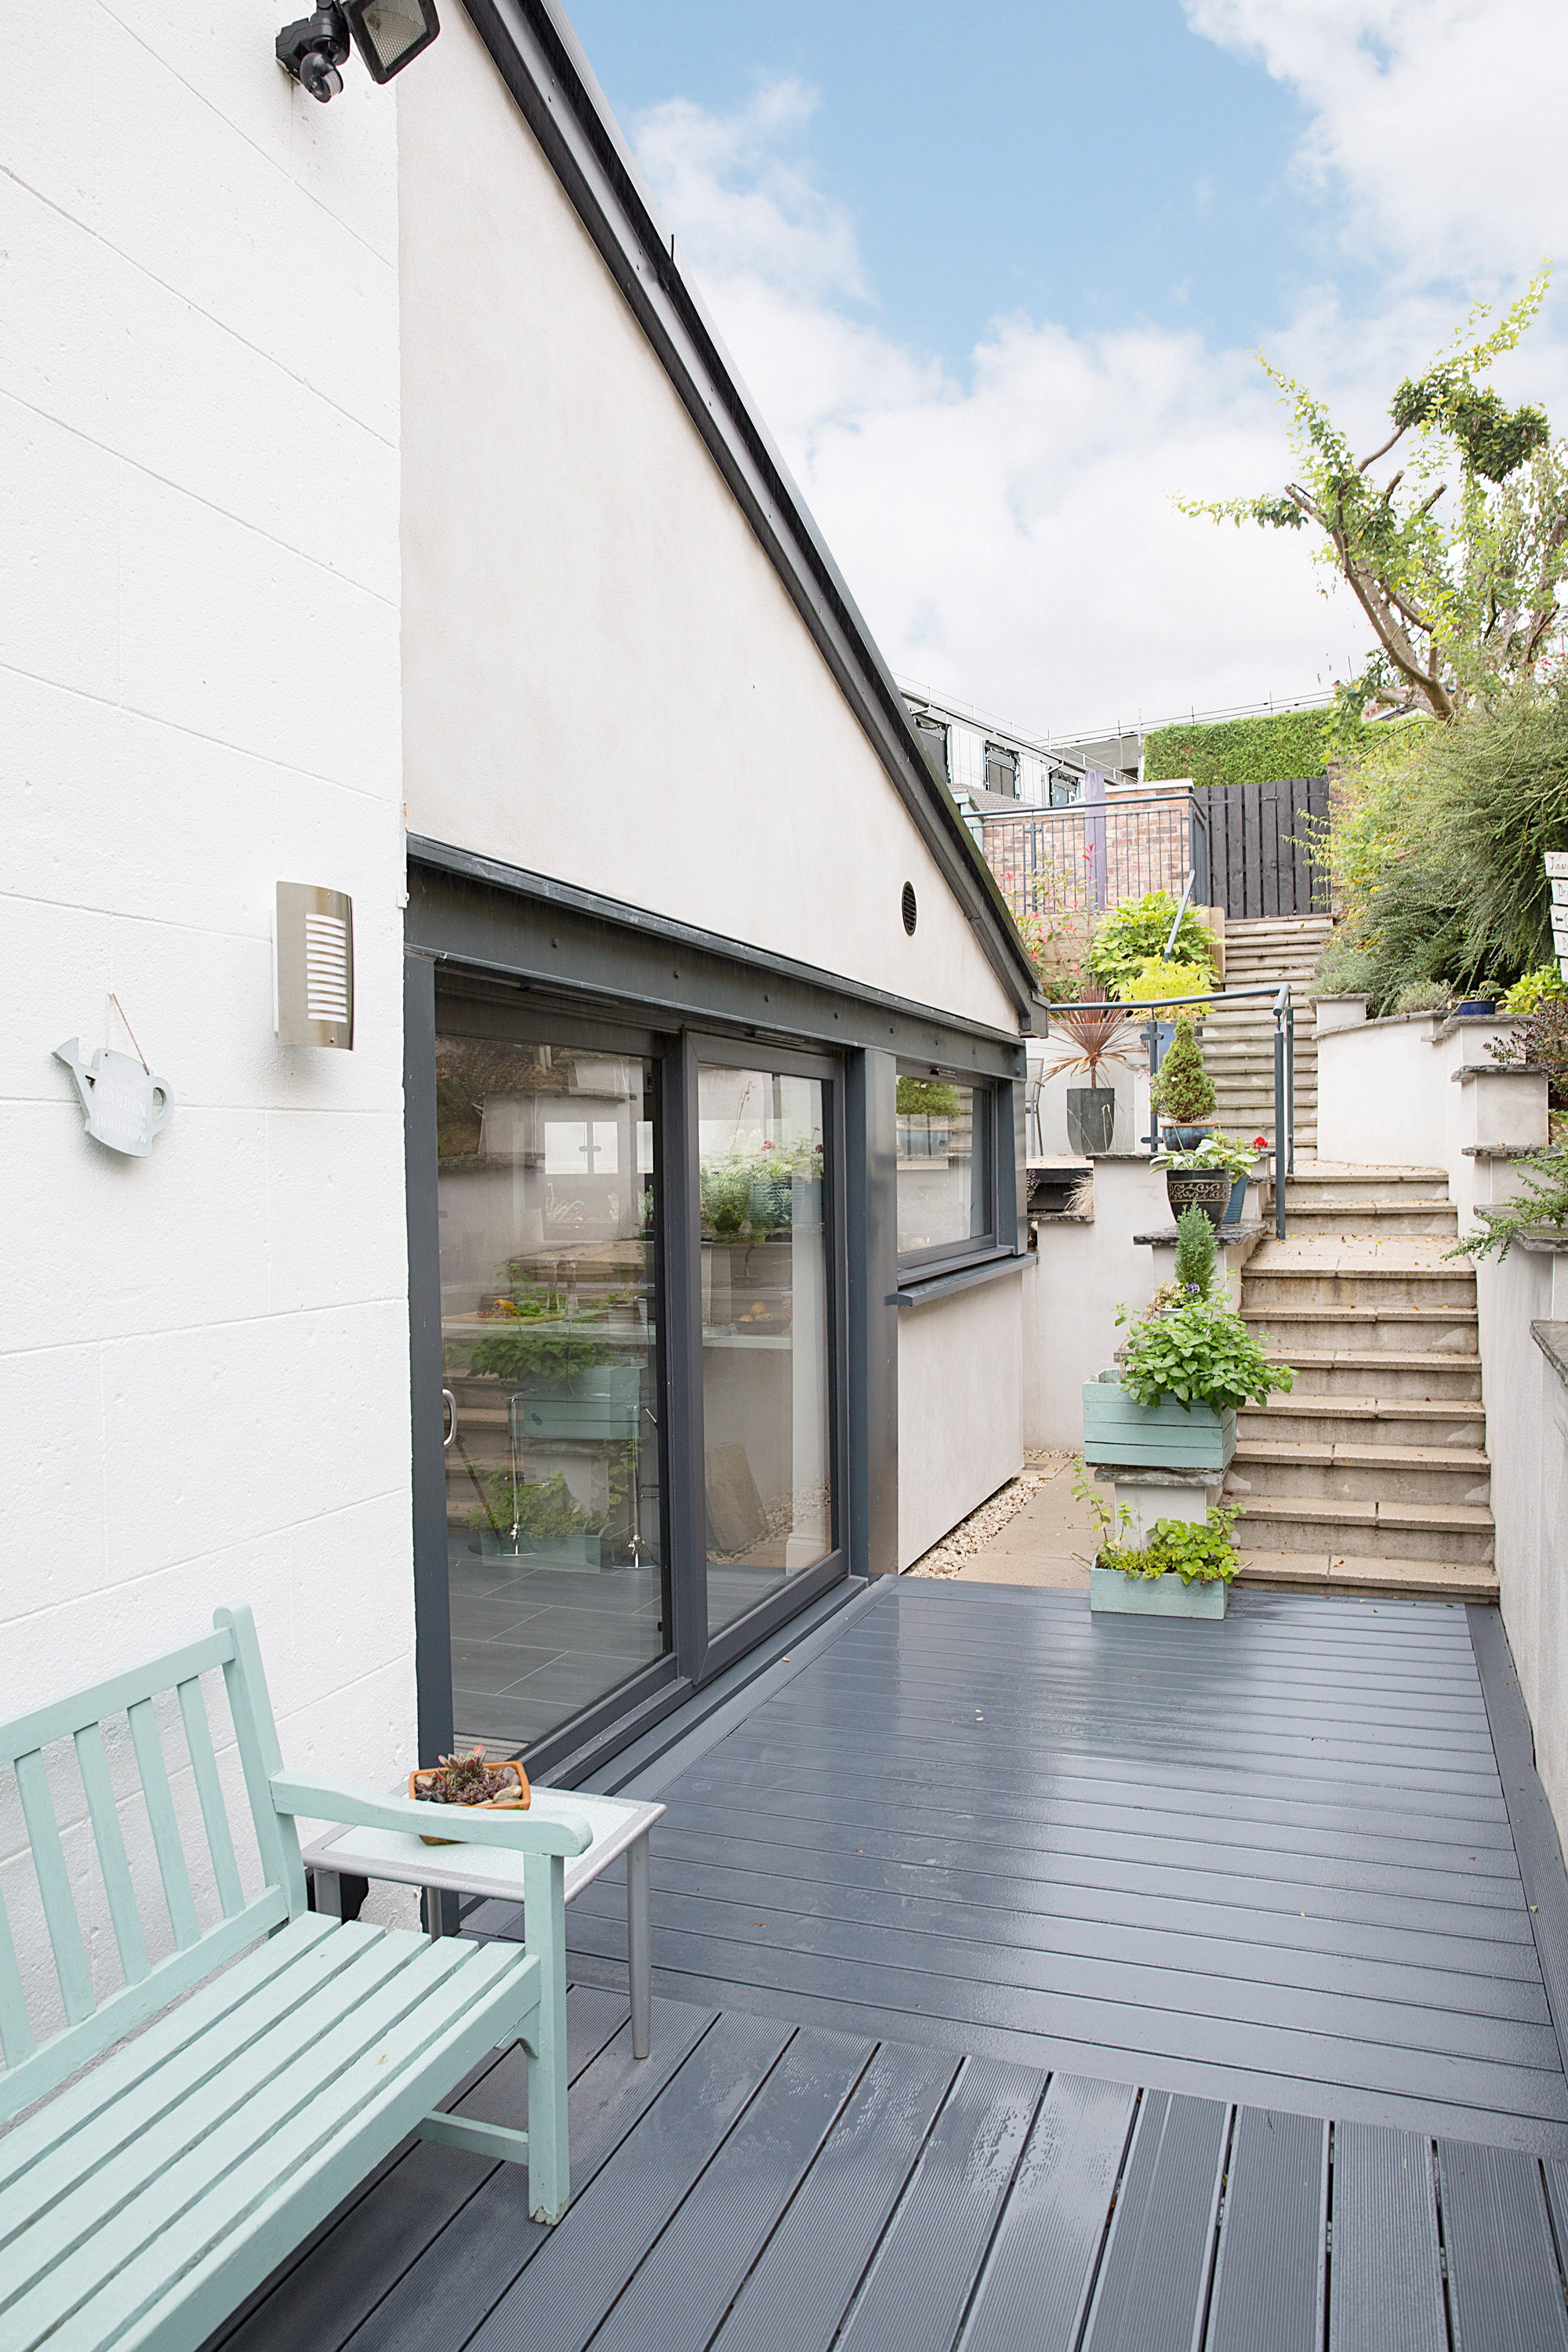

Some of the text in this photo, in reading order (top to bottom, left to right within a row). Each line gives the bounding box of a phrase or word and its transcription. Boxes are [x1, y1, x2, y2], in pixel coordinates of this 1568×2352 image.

[100, 1087, 147, 1118] GARDEN
[107, 1078, 143, 1101] TO PLANT A
[95, 1112, 148, 1143] TOMORROW
